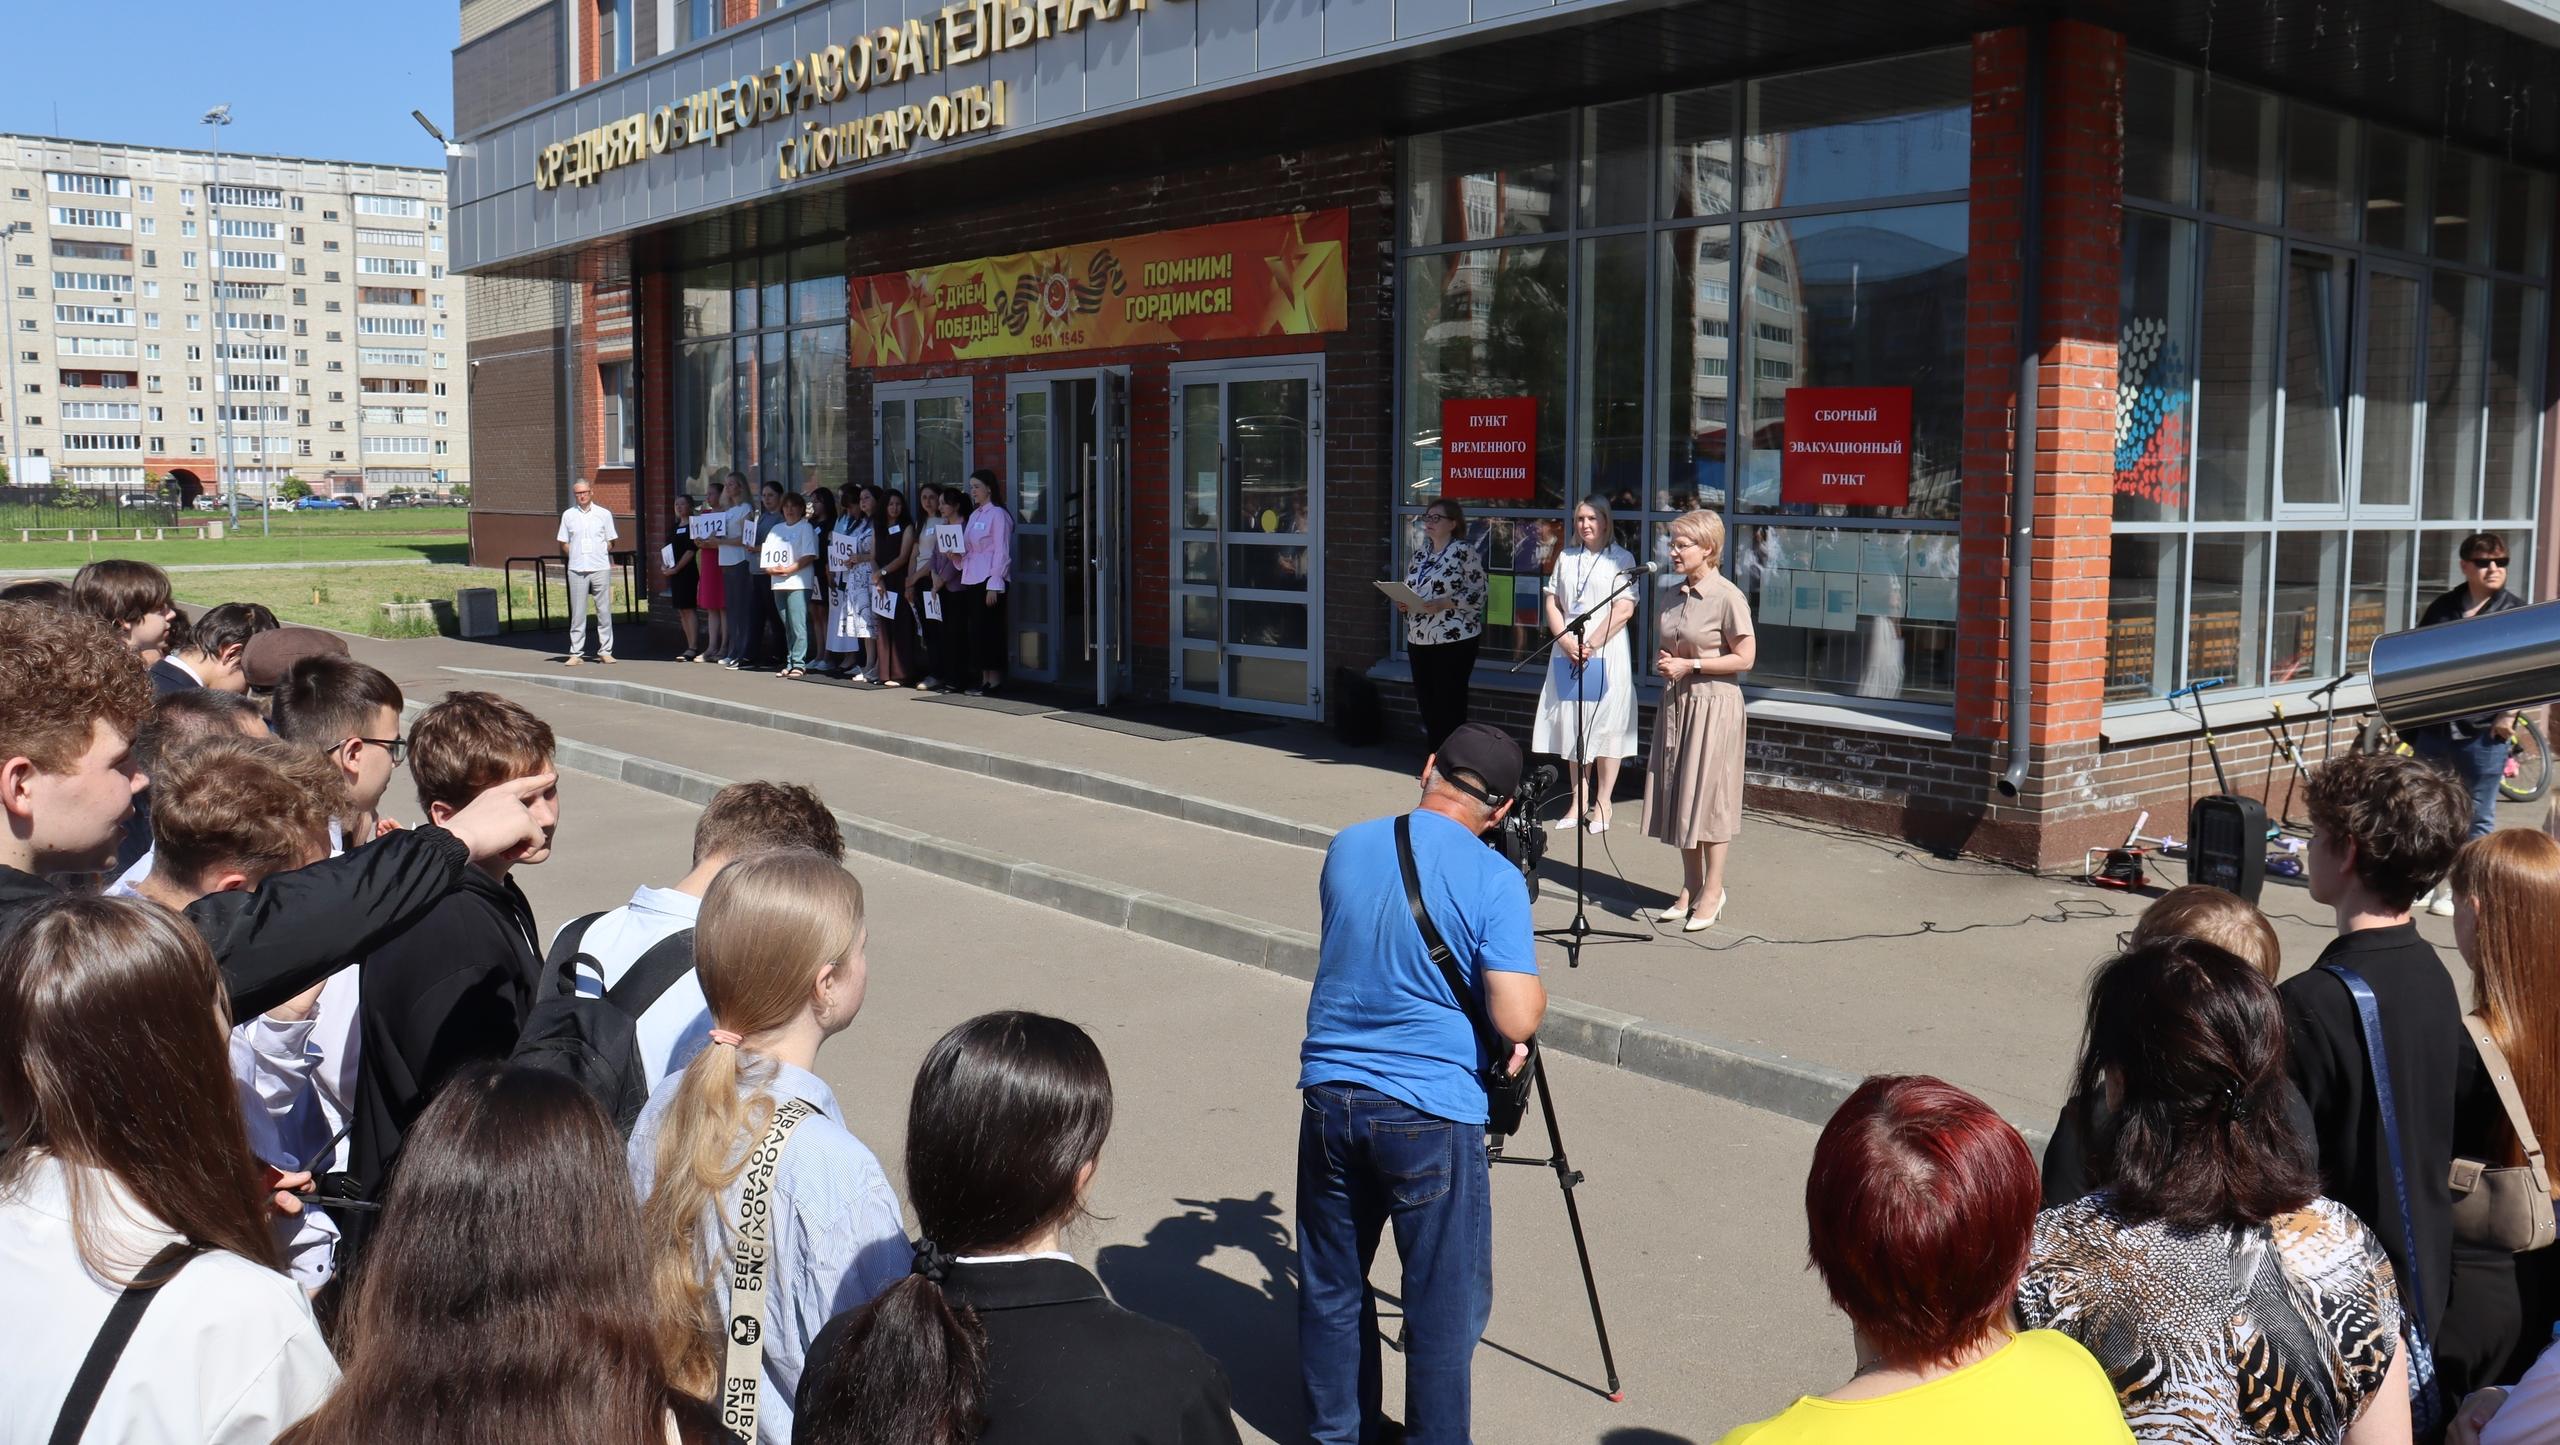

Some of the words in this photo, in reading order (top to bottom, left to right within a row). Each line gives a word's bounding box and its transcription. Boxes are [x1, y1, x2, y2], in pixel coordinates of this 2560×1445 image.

[535, 112, 649, 191] СРЕДНЯЯ
[649, 0, 1147, 154] ОБЩЕОБРАЗОВАТЕЛЬН
[1143, 253, 1232, 288] ПОМНИМ!
[935, 288, 944, 309] С
[946, 280, 987, 311] ДНЁМ
[1125, 286, 1232, 322] ГОРДИМСЯ!
[936, 311, 999, 340] ПОБЕДЫ!
[1030, 334, 1052, 348] 1941
[1469, 415, 1508, 427] ПУНКТ
[1815, 407, 1878, 422] СБОРНЫЙ
[1451, 441, 1527, 453] ВРЕМЕННОГО
[1789, 440, 1903, 455] ЭВАКУАЦИОННЫЙ
[1450, 467, 1526, 480] РАЗМЕЩЕНИЯ
[1822, 473, 1865, 486] ПУНКТ
[704, 520, 723, 533] 112
[835, 541, 853, 556] 105
[940, 534, 958, 548] 101
[765, 551, 788, 563] 108
[874, 597, 891, 613] 104
